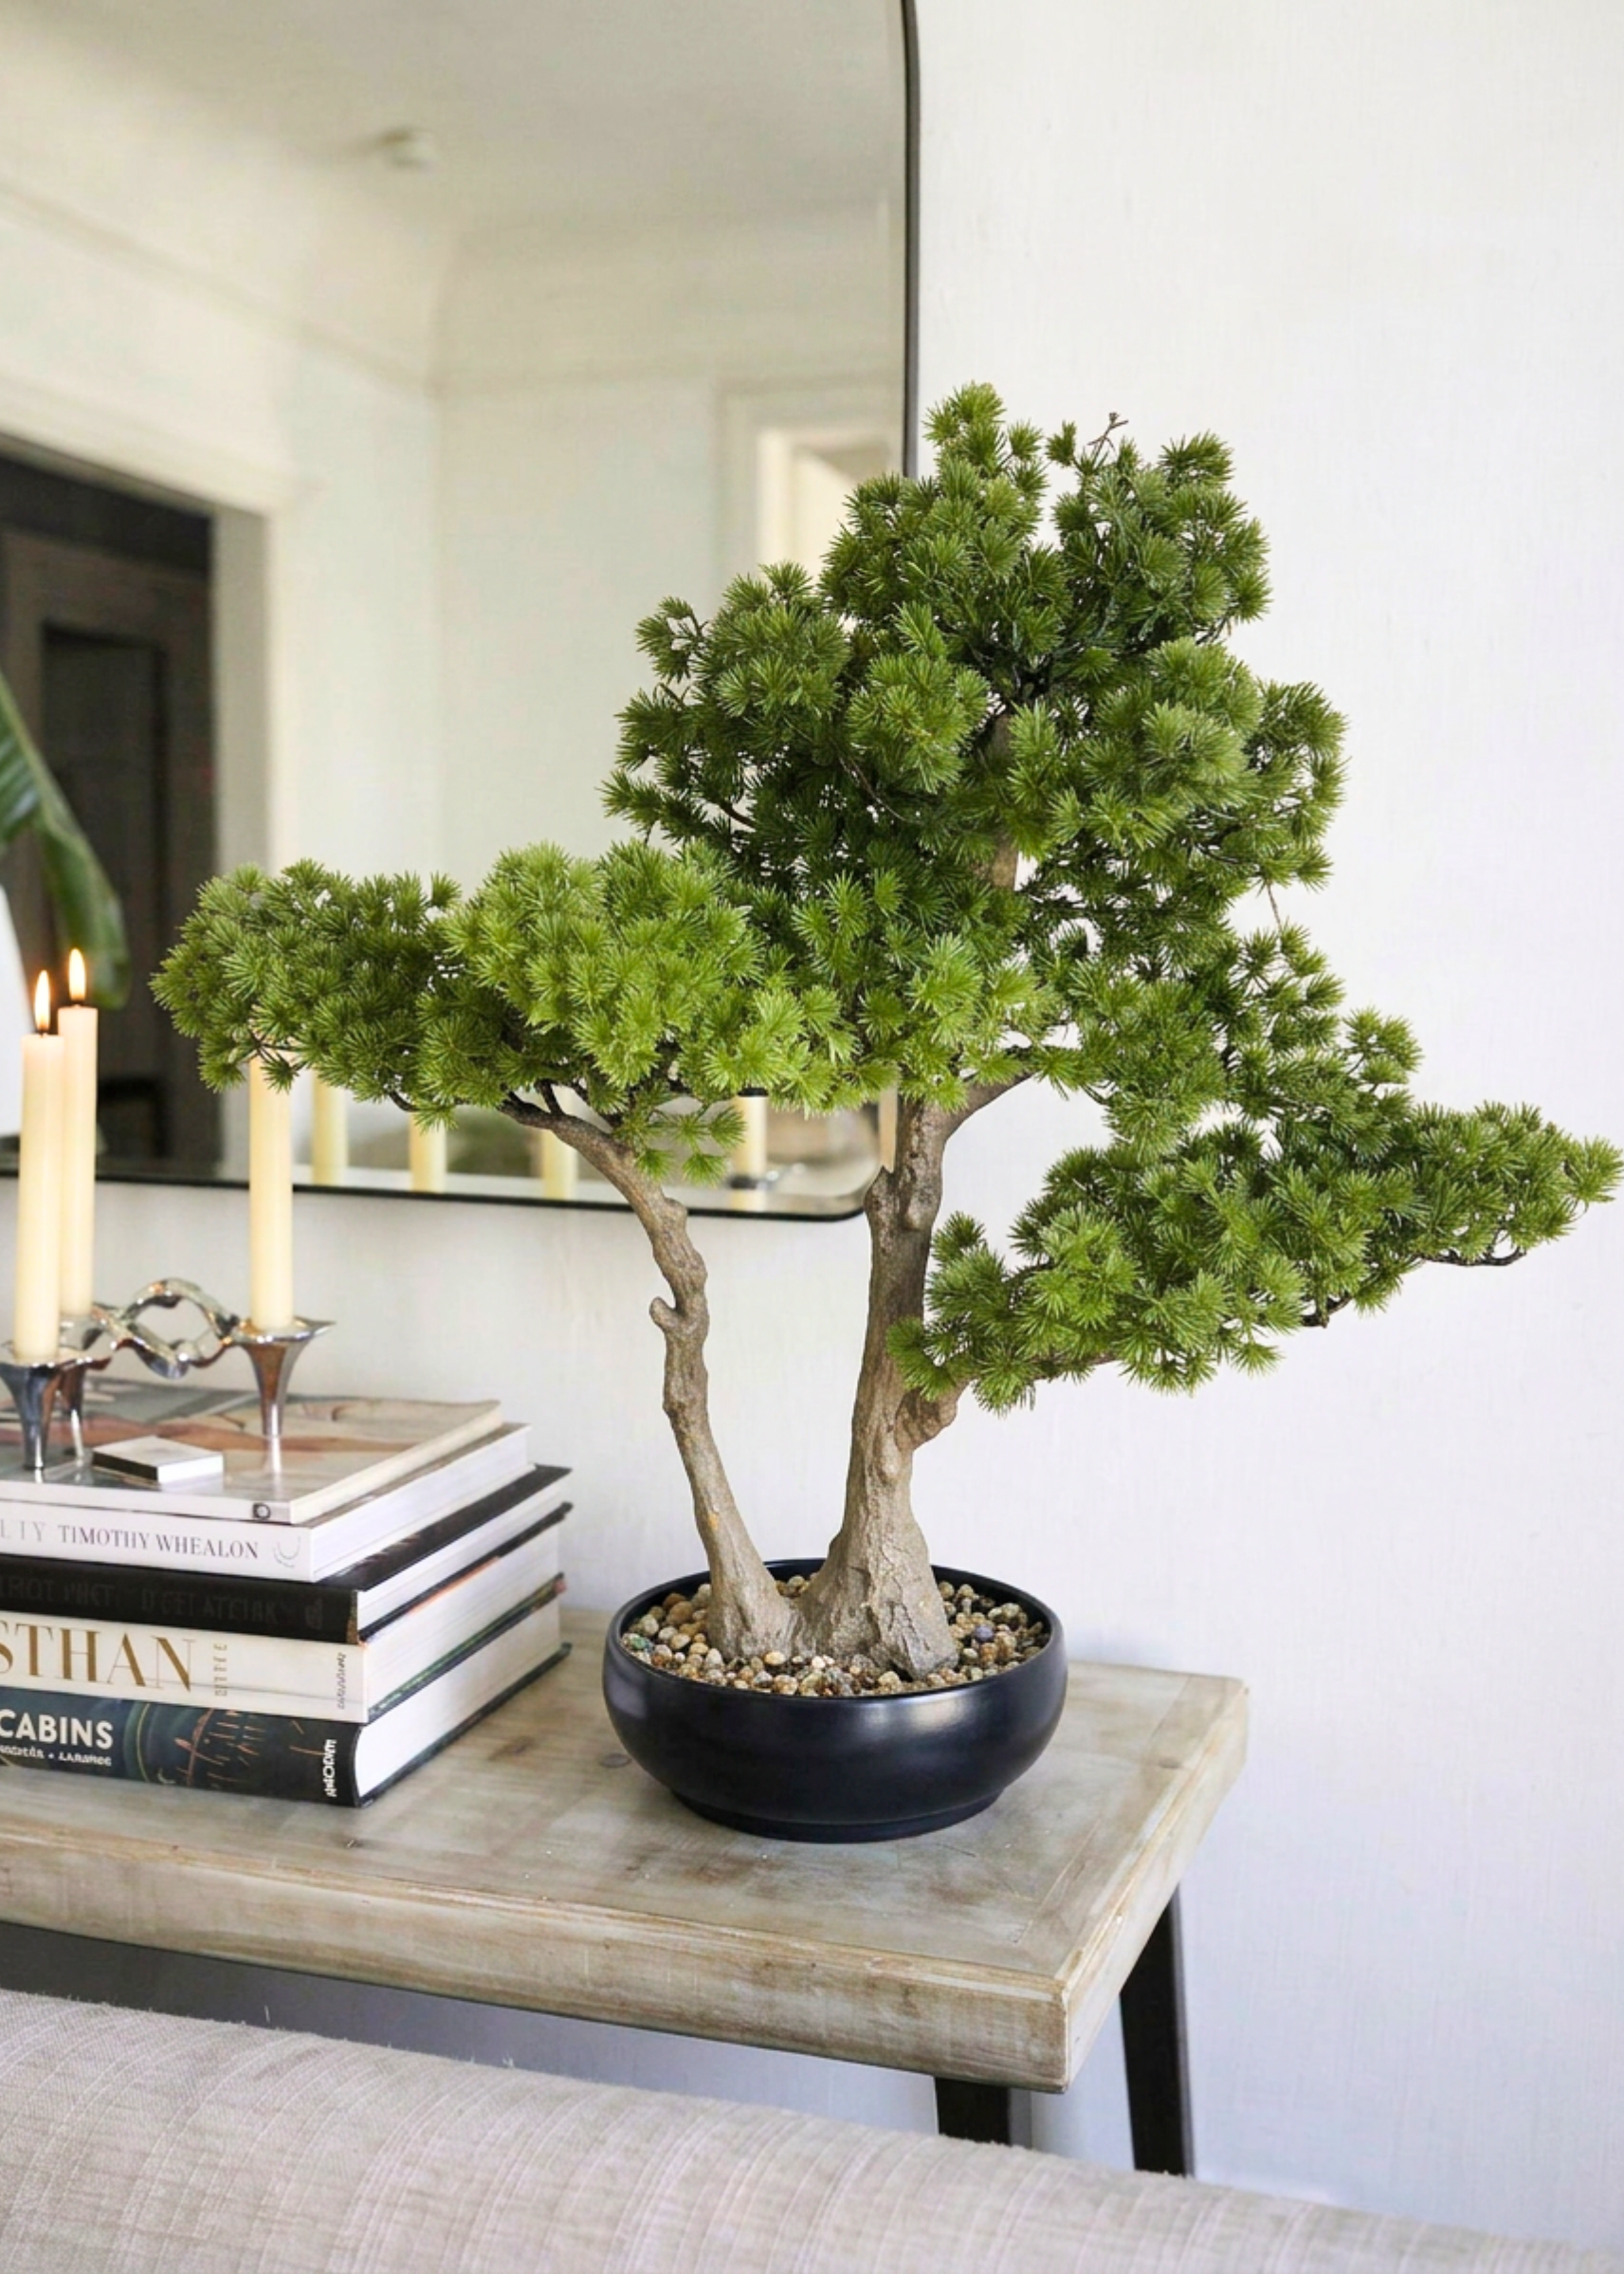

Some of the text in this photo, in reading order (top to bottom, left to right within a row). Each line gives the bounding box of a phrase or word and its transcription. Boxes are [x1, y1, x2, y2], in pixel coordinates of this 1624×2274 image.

[58, 1524, 150, 1550] TIMOTHY
[155, 1533, 259, 1559] WHEALON
[0, 1709, 114, 1750] CABINS
